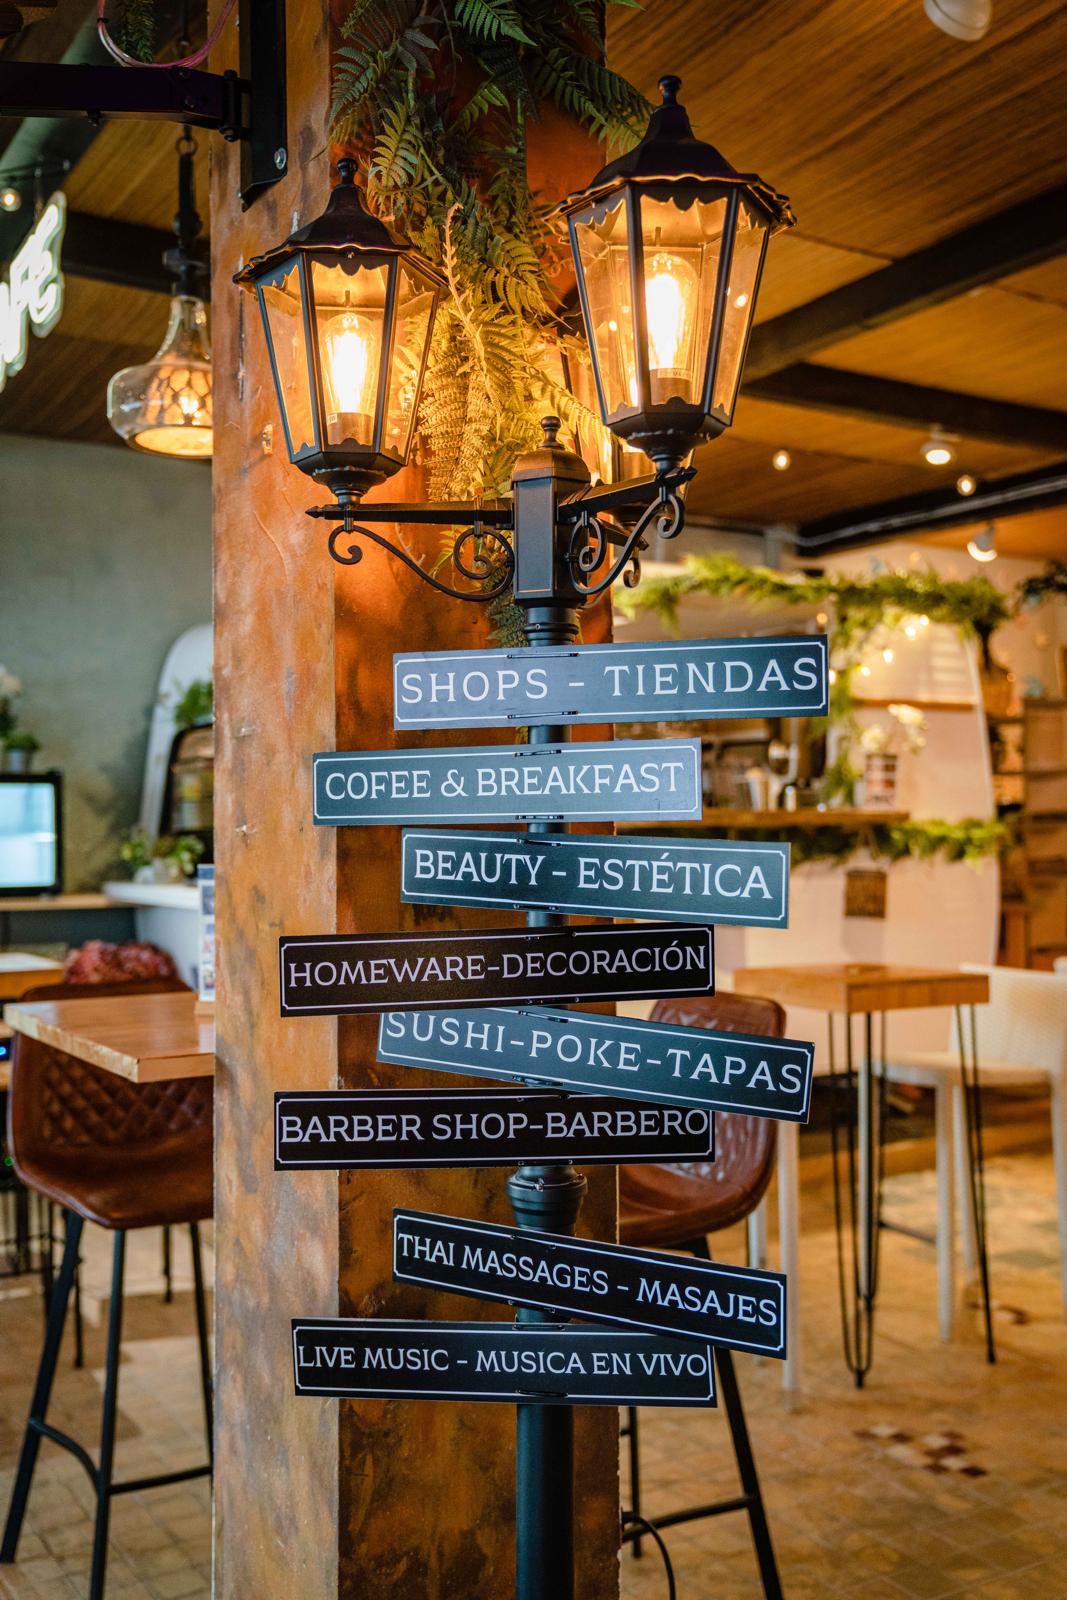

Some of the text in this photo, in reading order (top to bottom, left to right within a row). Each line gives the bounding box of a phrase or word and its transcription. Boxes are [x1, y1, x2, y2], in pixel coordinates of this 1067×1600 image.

[401, 668, 548, 704] SHOPS
[604, 657, 818, 697] TIENDAS
[325, 762, 683, 800] COFEE & BREAKFAST
[414, 849, 546, 886] BEAUTY
[577, 852, 773, 899] ESTÉTICA
[280, 1115, 424, 1143] BARBER
[398, 1233, 455, 1267] THAI
[461, 1245, 609, 1295] MASSAGES
[636, 1278, 777, 1326] MASAJES
[298, 1346, 356, 1368] LIVE
[362, 1347, 449, 1371] MUSIC
[475, 1350, 586, 1374] MUSICA
[592, 1352, 631, 1375] EN
[636, 1353, 707, 1376] VIVO
